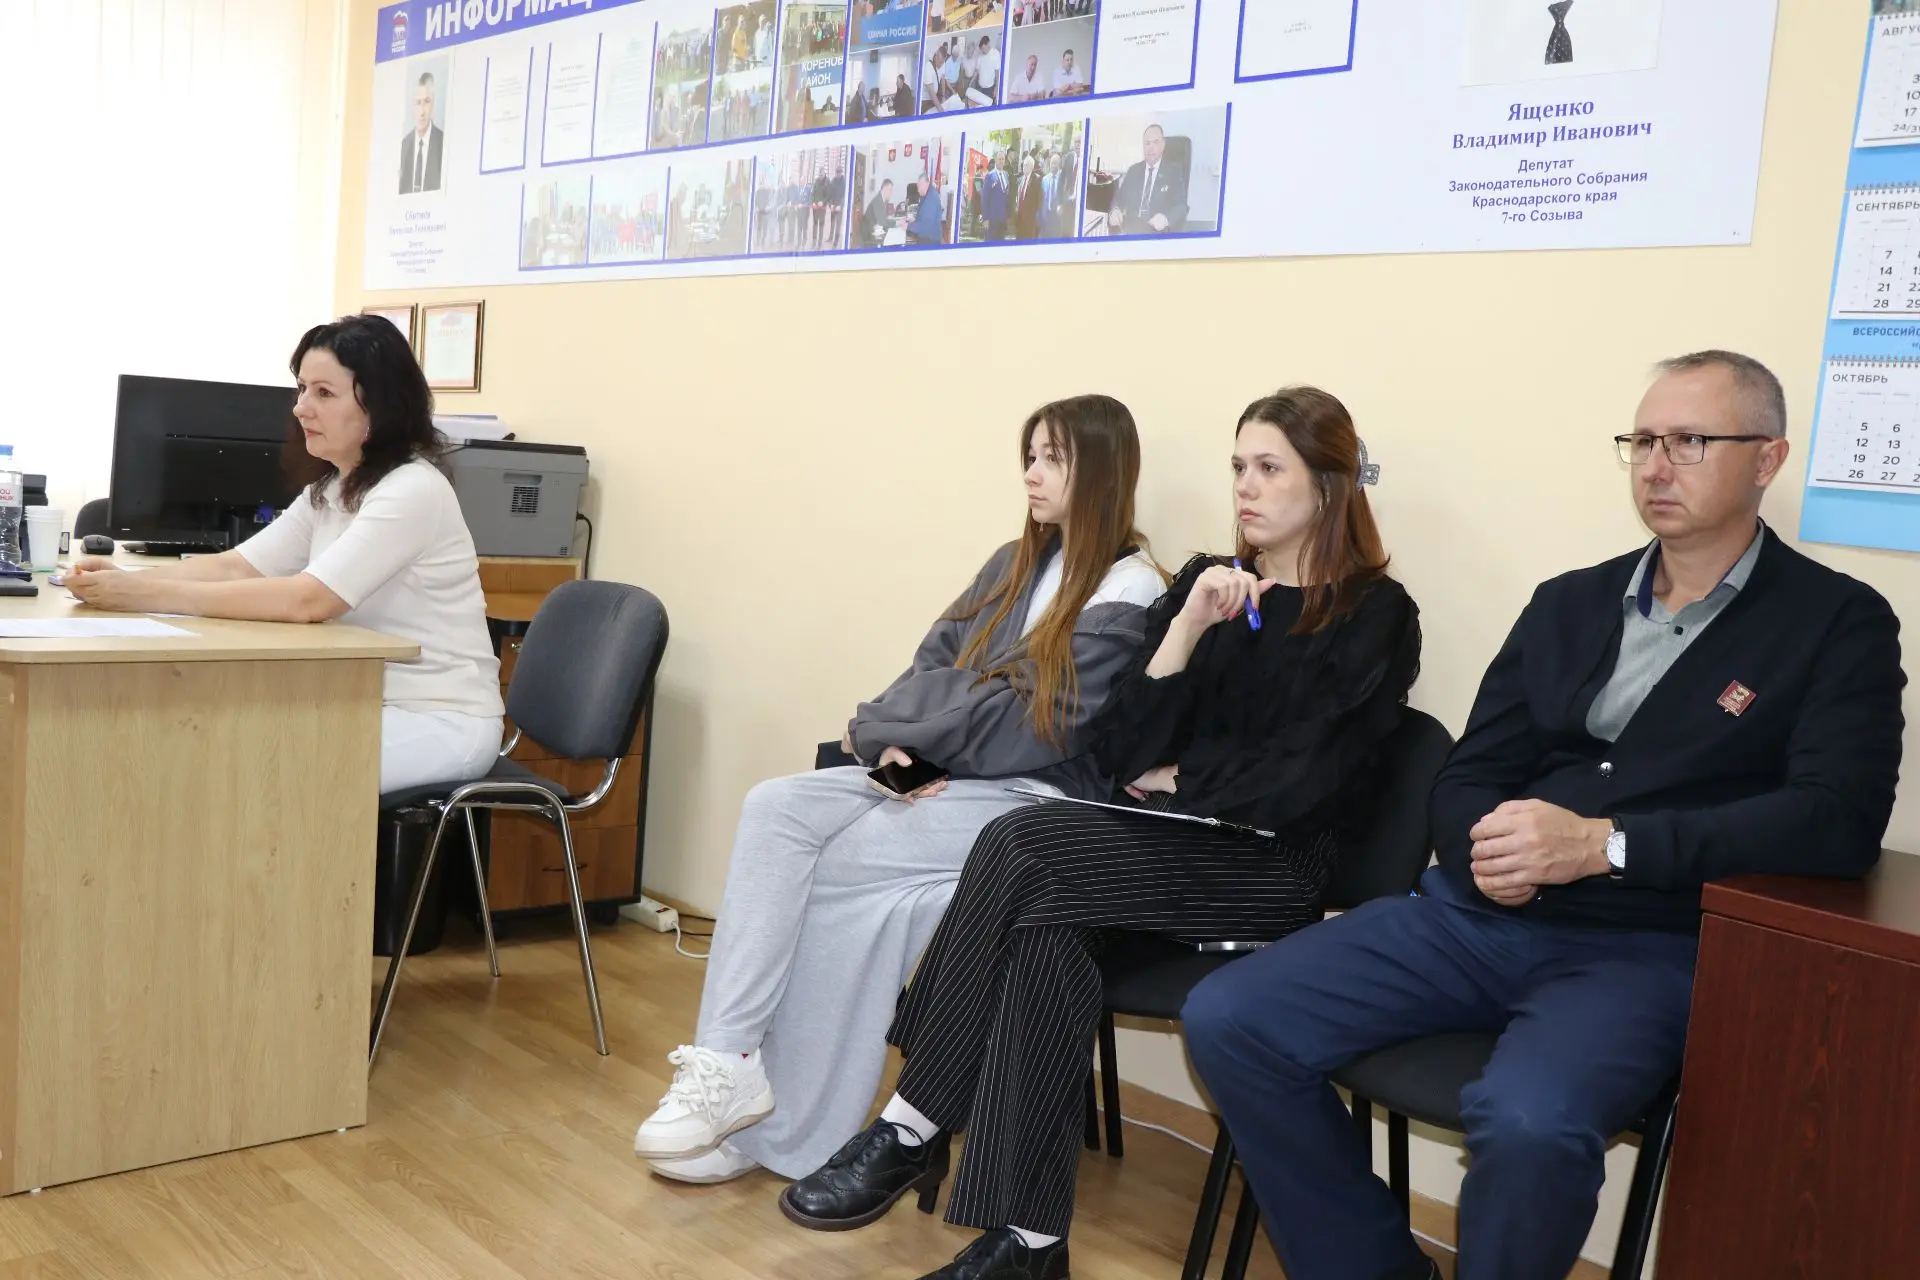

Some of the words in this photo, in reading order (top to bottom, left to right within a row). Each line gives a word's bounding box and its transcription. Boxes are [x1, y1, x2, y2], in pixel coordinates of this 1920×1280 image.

[889, 24, 917, 37] РОССИЯ
[1507, 100, 1595, 122] Ященко
[1905, 107, 1917, 117] 17
[1452, 129, 1547, 150] Владимир
[1552, 121, 1652, 142] Иванович
[1518, 158, 1574, 174] Депутат
[1448, 175, 1572, 192] Законодательного
[1576, 171, 1648, 187] Собрания
[1472, 192, 1581, 210] Краснодарского
[1585, 190, 1618, 203] края
[1856, 200, 1920, 212] СЕНТЯБРЬ
[1502, 211, 1526, 224] 7-го
[1530, 208, 1583, 222] Созыва
[1885, 250, 1893, 260] 7
[1880, 266, 1893, 276] 14
[1877, 282, 1890, 292] 21
[1873, 299, 1889, 308] 28
[1832, 373, 1888, 384] ОКТЯБРЬ
[1860, 422, 1868, 432] 5
[1892, 423, 1901, 433] 6
[1855, 438, 1869, 447] 12
[1887, 439, 1901, 449] 13
[1853, 454, 1866, 464] 19
[1882, 455, 1901, 465] 20
[1848, 469, 1864, 479] 26
[1880, 471, 1897, 481] 27
